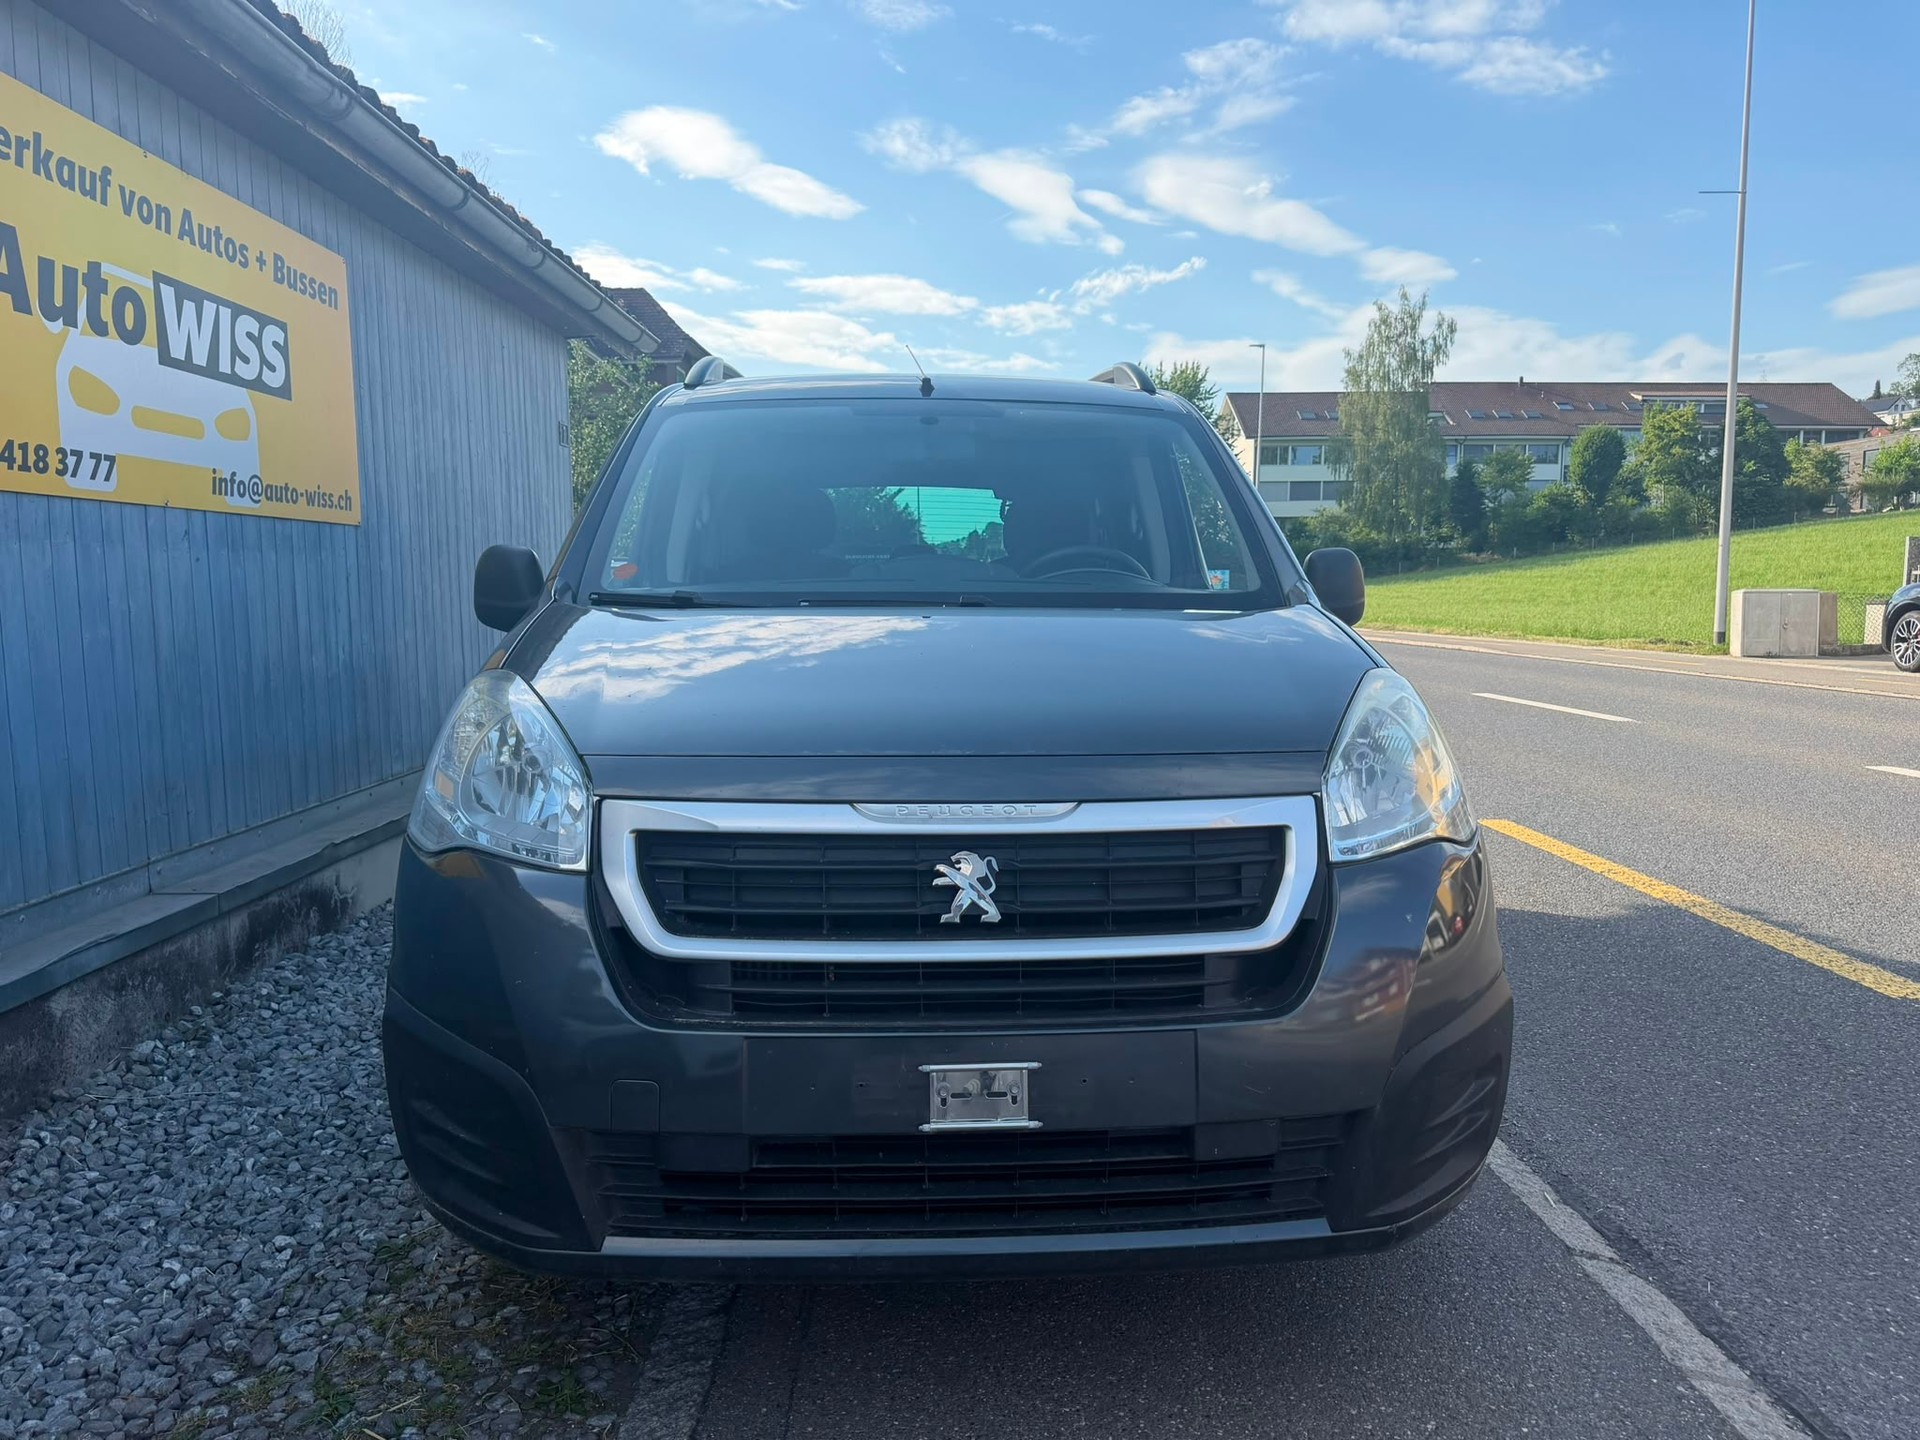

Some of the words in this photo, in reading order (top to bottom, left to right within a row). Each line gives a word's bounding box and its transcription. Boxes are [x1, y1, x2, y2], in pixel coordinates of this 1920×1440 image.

[118, 183, 172, 234] von
[177, 208, 250, 269] Autos
[255, 250, 267, 272] +
[272, 252, 339, 311] Bussen
[0, 222, 147, 346] Auto
[159, 281, 286, 388] WISS
[0, 439, 49, 475] 418
[55, 446, 84, 479] 37
[89, 451, 117, 482] 77
[212, 468, 352, 511] info@auto-wiss.ch
[895, 804, 1037, 816] PEUGEOT
